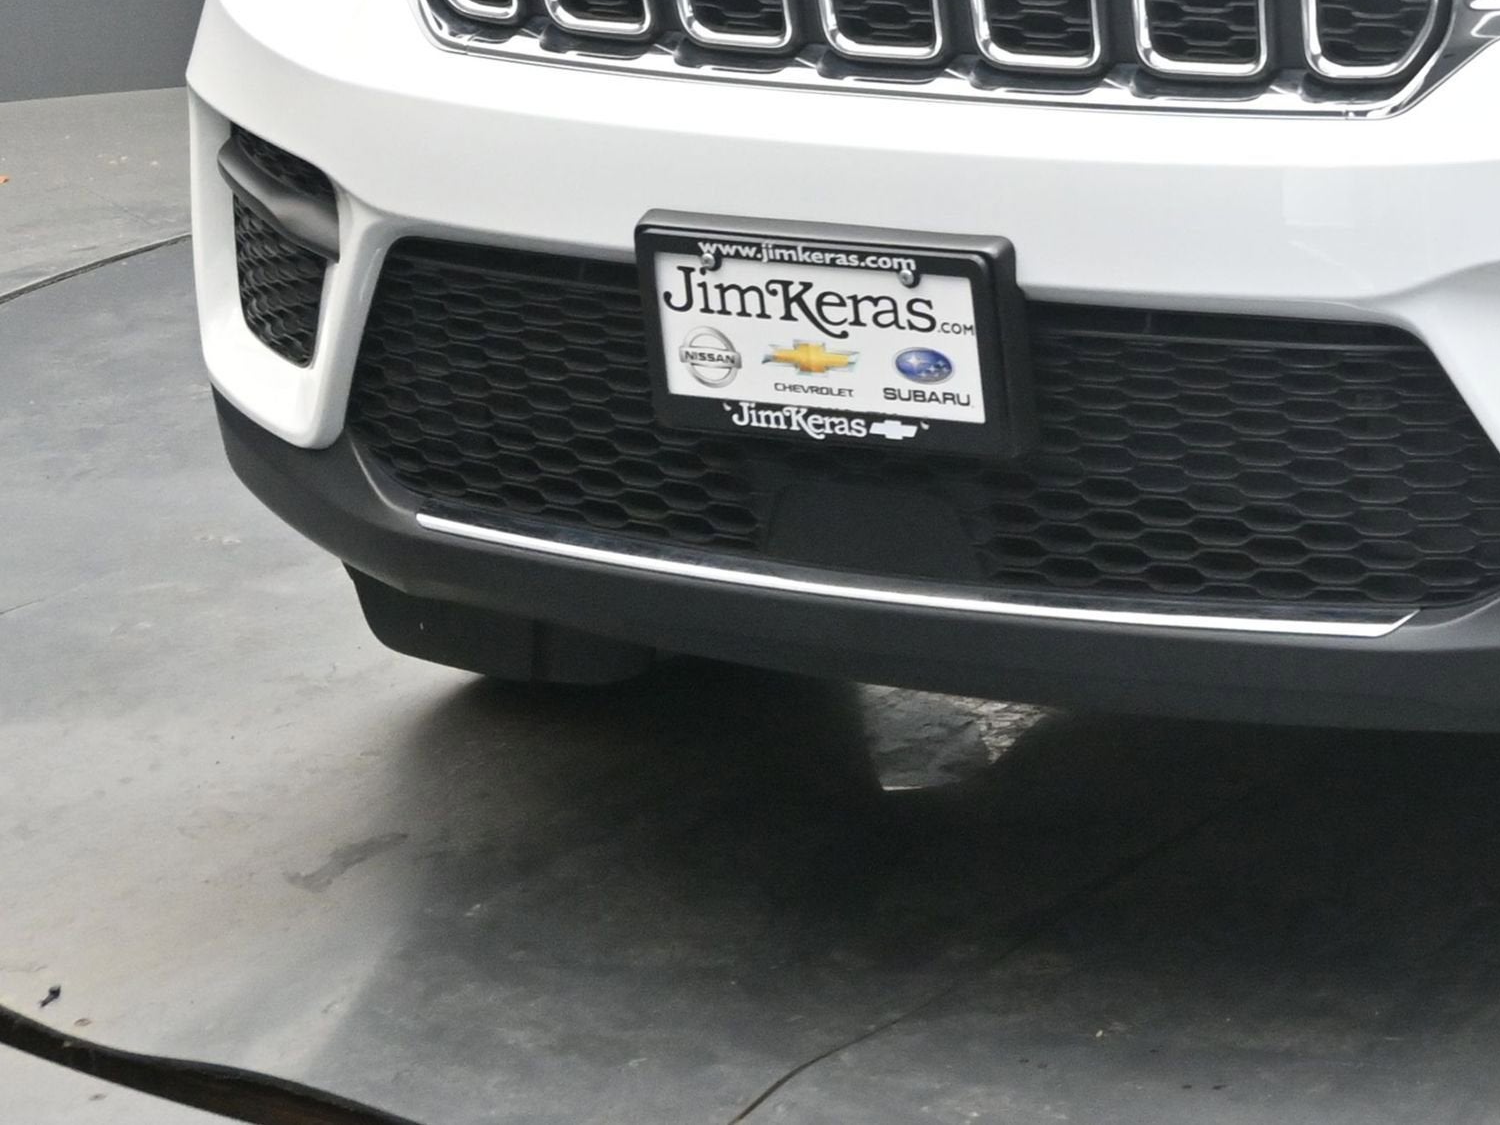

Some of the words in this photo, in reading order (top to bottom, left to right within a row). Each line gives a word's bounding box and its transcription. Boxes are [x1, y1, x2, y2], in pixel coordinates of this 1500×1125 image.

[698, 241, 917, 272] www.jimkeras.com
[684, 350, 736, 364] NISSAN
[774, 382, 854, 398] CHEVROLET
[883, 387, 970, 408] SUBARU
